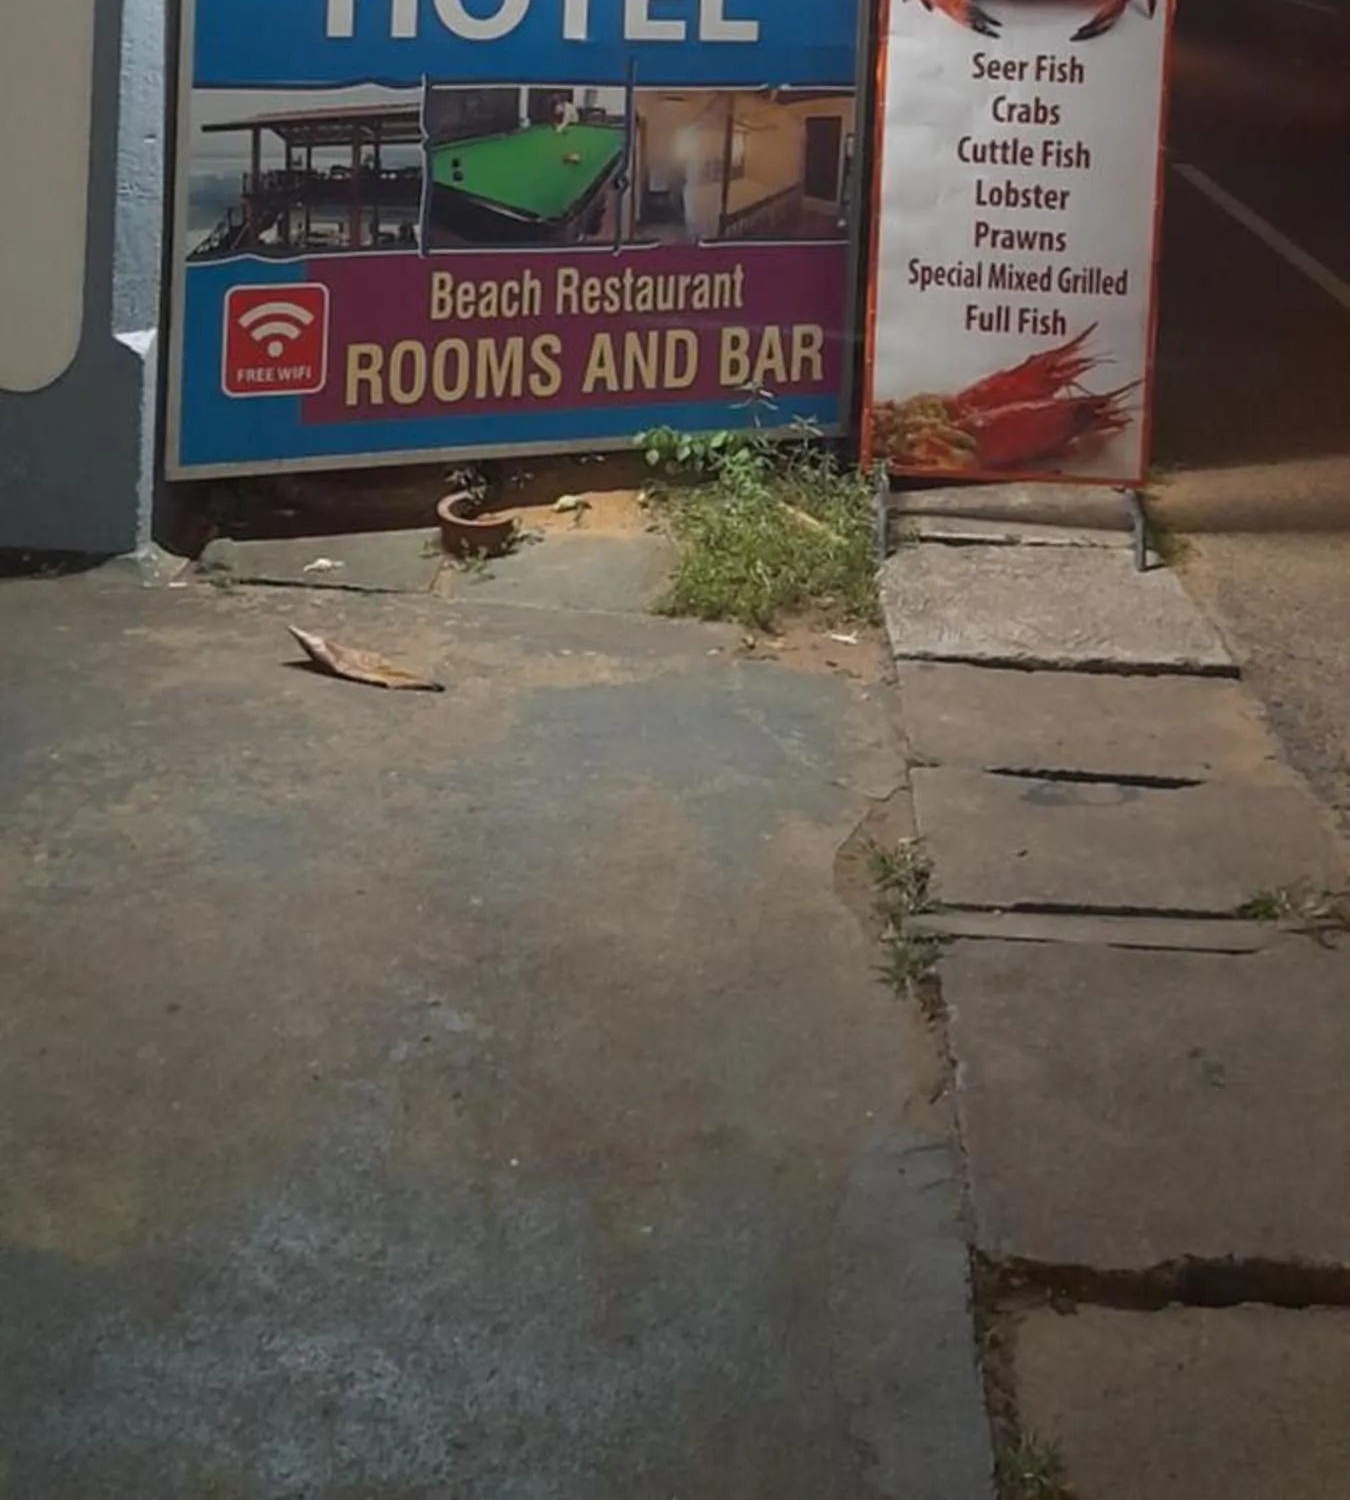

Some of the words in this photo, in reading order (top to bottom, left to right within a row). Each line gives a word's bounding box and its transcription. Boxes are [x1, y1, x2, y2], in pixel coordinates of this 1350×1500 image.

[971, 52, 1029, 81] Seer
[1035, 55, 1085, 84] Fish
[991, 95, 1061, 125] Crabs
[957, 136, 1034, 166] Cuttle
[1041, 140, 1091, 169] Fish
[975, 179, 1070, 210] Lobster
[974, 221, 1067, 252] Prawns
[429, 264, 542, 320] Beach
[556, 262, 745, 315] Restaurant
[908, 258, 983, 291] Special
[988, 262, 1051, 293] Mixed
[1057, 266, 1128, 296] Grilled
[965, 304, 1010, 333] Full
[1018, 307, 1067, 336] Fish
[237, 366, 274, 382] FREE
[345, 333, 563, 407] ROOMS
[581, 328, 699, 393] AND
[719, 323, 824, 386] BAR
